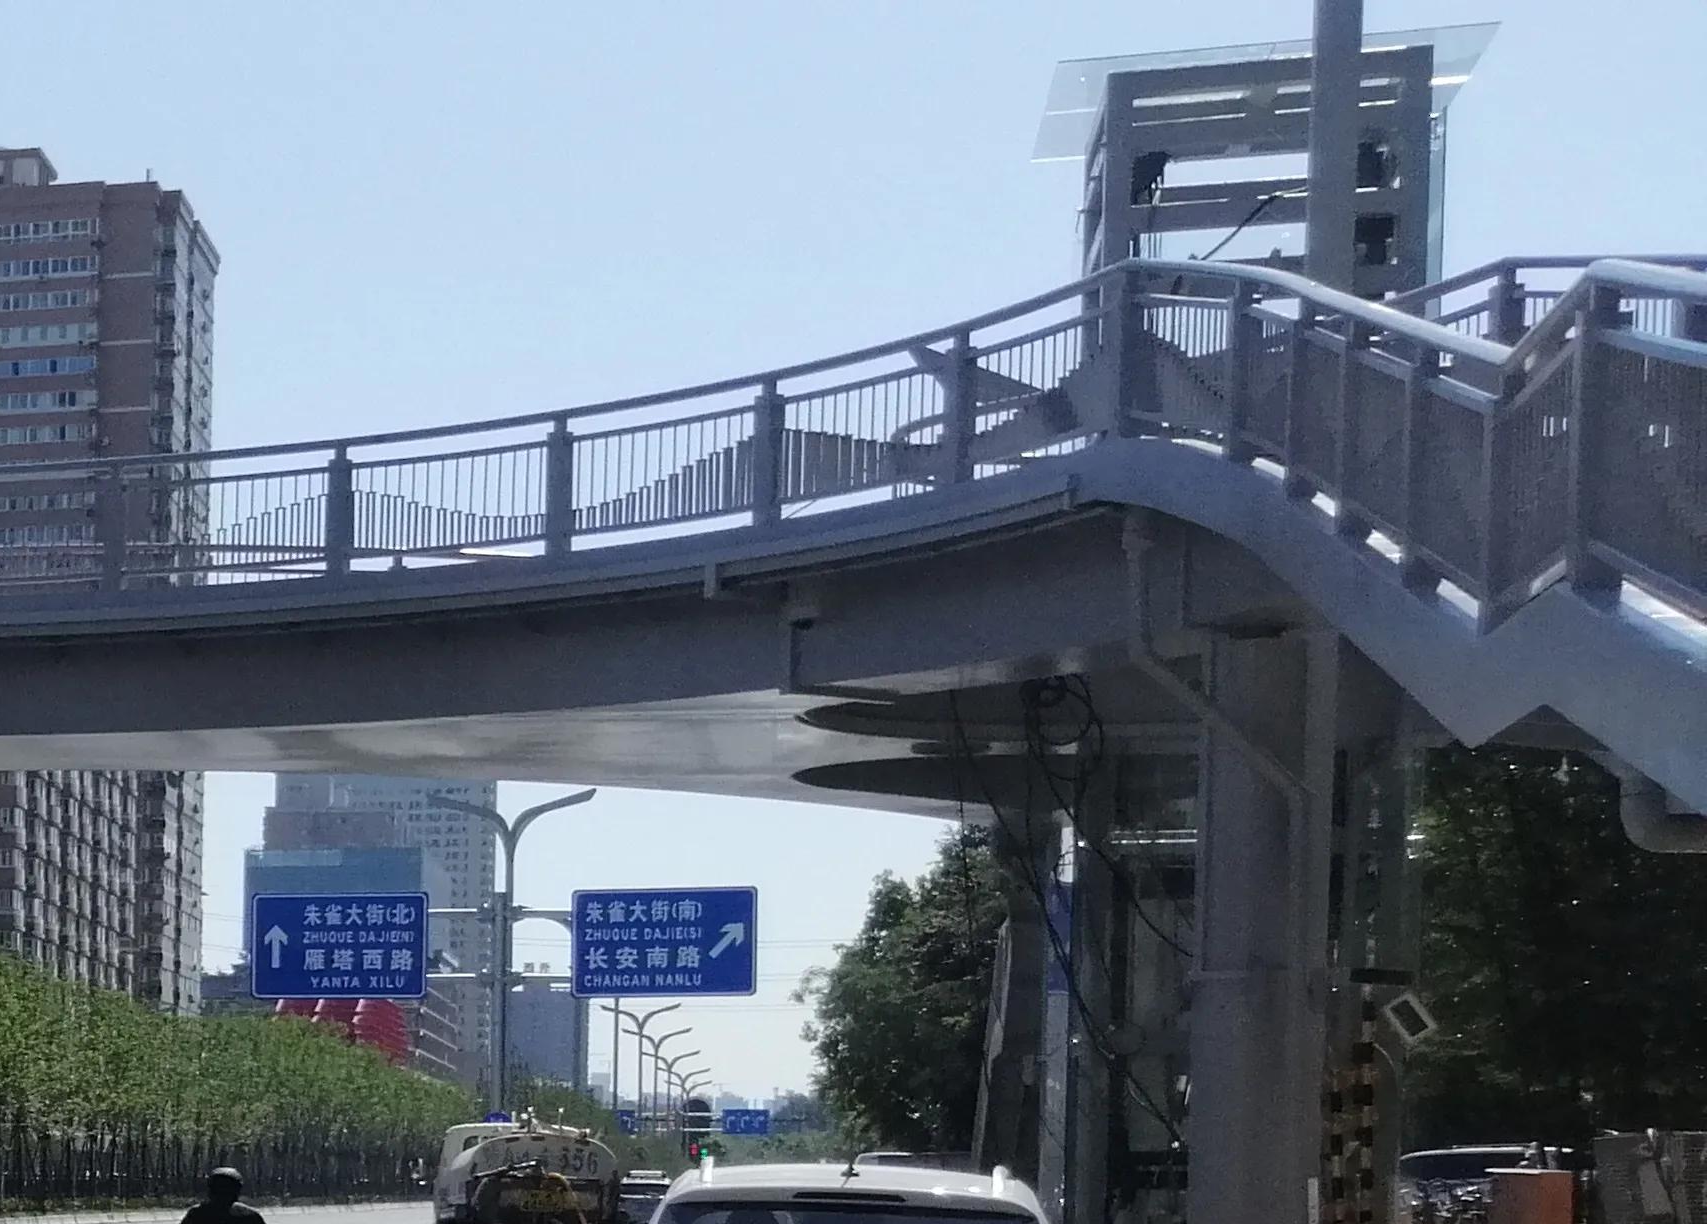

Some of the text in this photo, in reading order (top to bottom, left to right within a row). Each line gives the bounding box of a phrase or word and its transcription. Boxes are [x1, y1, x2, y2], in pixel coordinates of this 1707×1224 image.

[303, 948, 413, 971] 雁塔西路
[584, 944, 701, 970] 长安南路
[310, 976, 405, 988] YANTA XILU
[584, 973, 703, 988] CHANGAN NANLU
